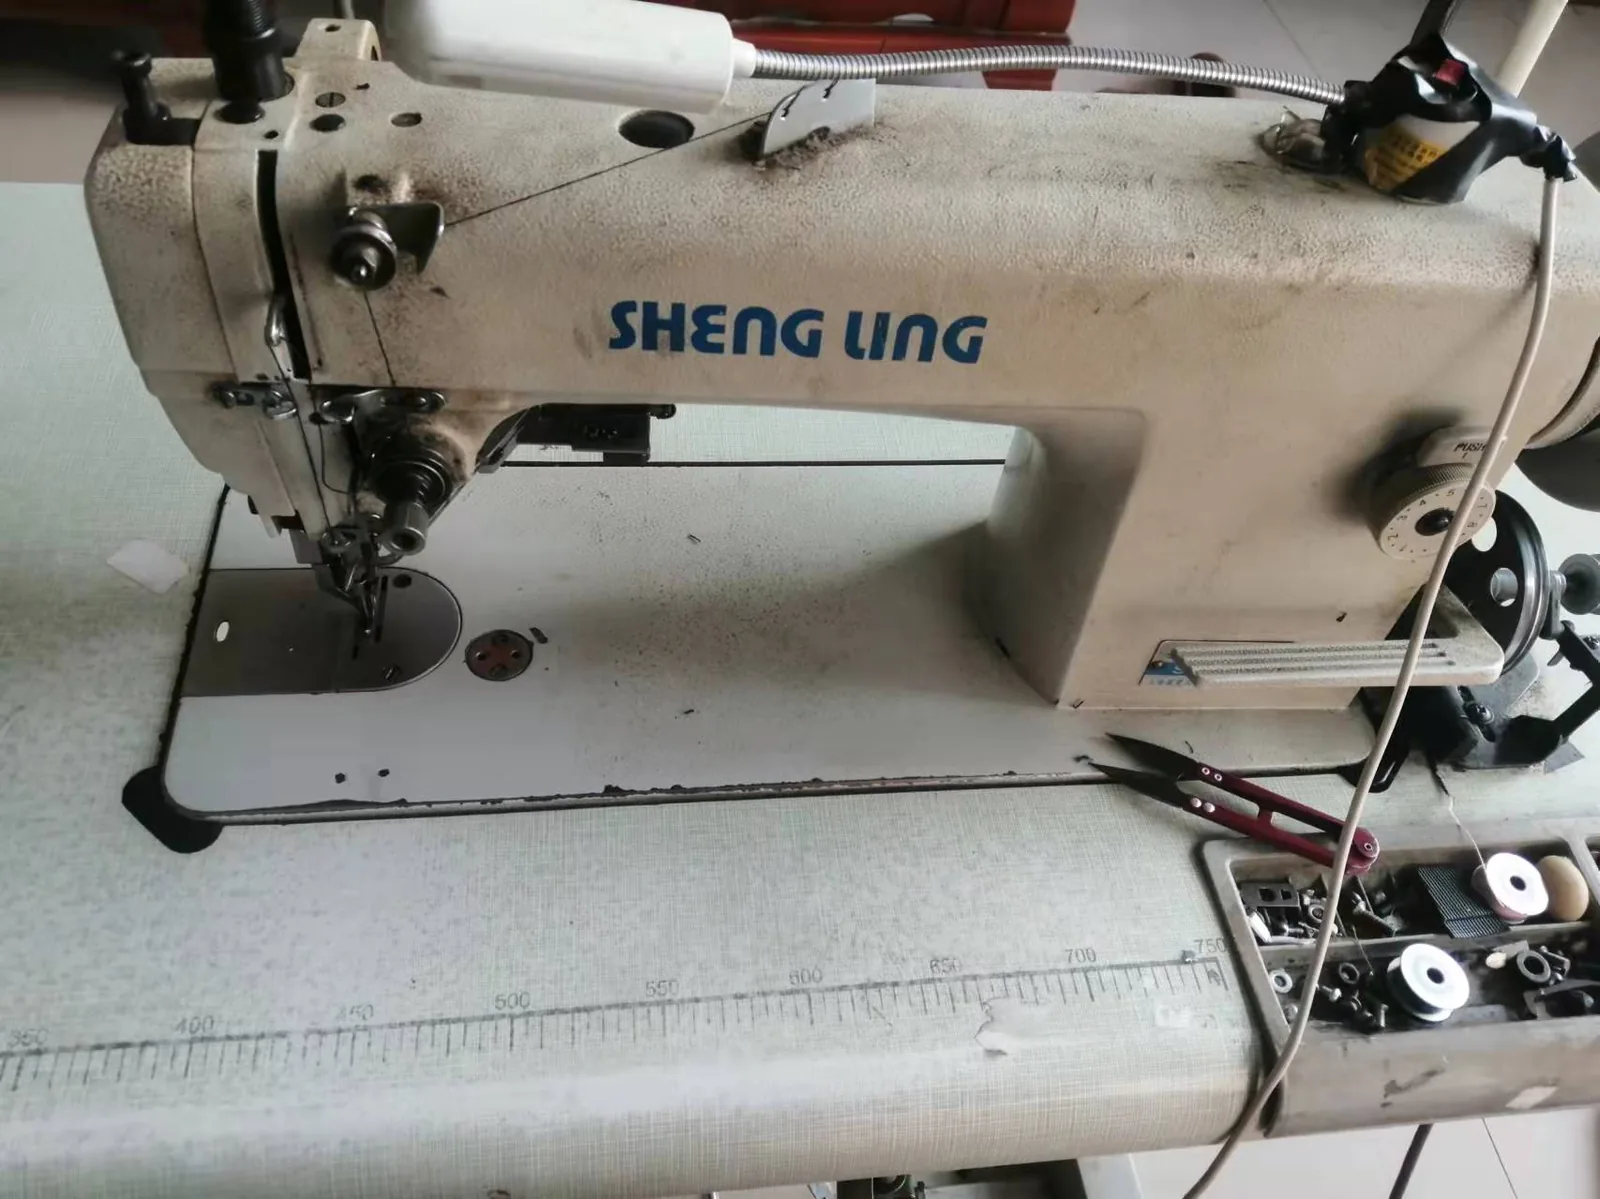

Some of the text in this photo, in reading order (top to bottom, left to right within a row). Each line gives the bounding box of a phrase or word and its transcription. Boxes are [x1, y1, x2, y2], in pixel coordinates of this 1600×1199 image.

[608, 300, 988, 364] SHENG LING
[494, 991, 530, 1010] 500
[645, 979, 679, 997] 550
[1064, 947, 1096, 964] 700
[1193, 937, 1226, 953] 750
